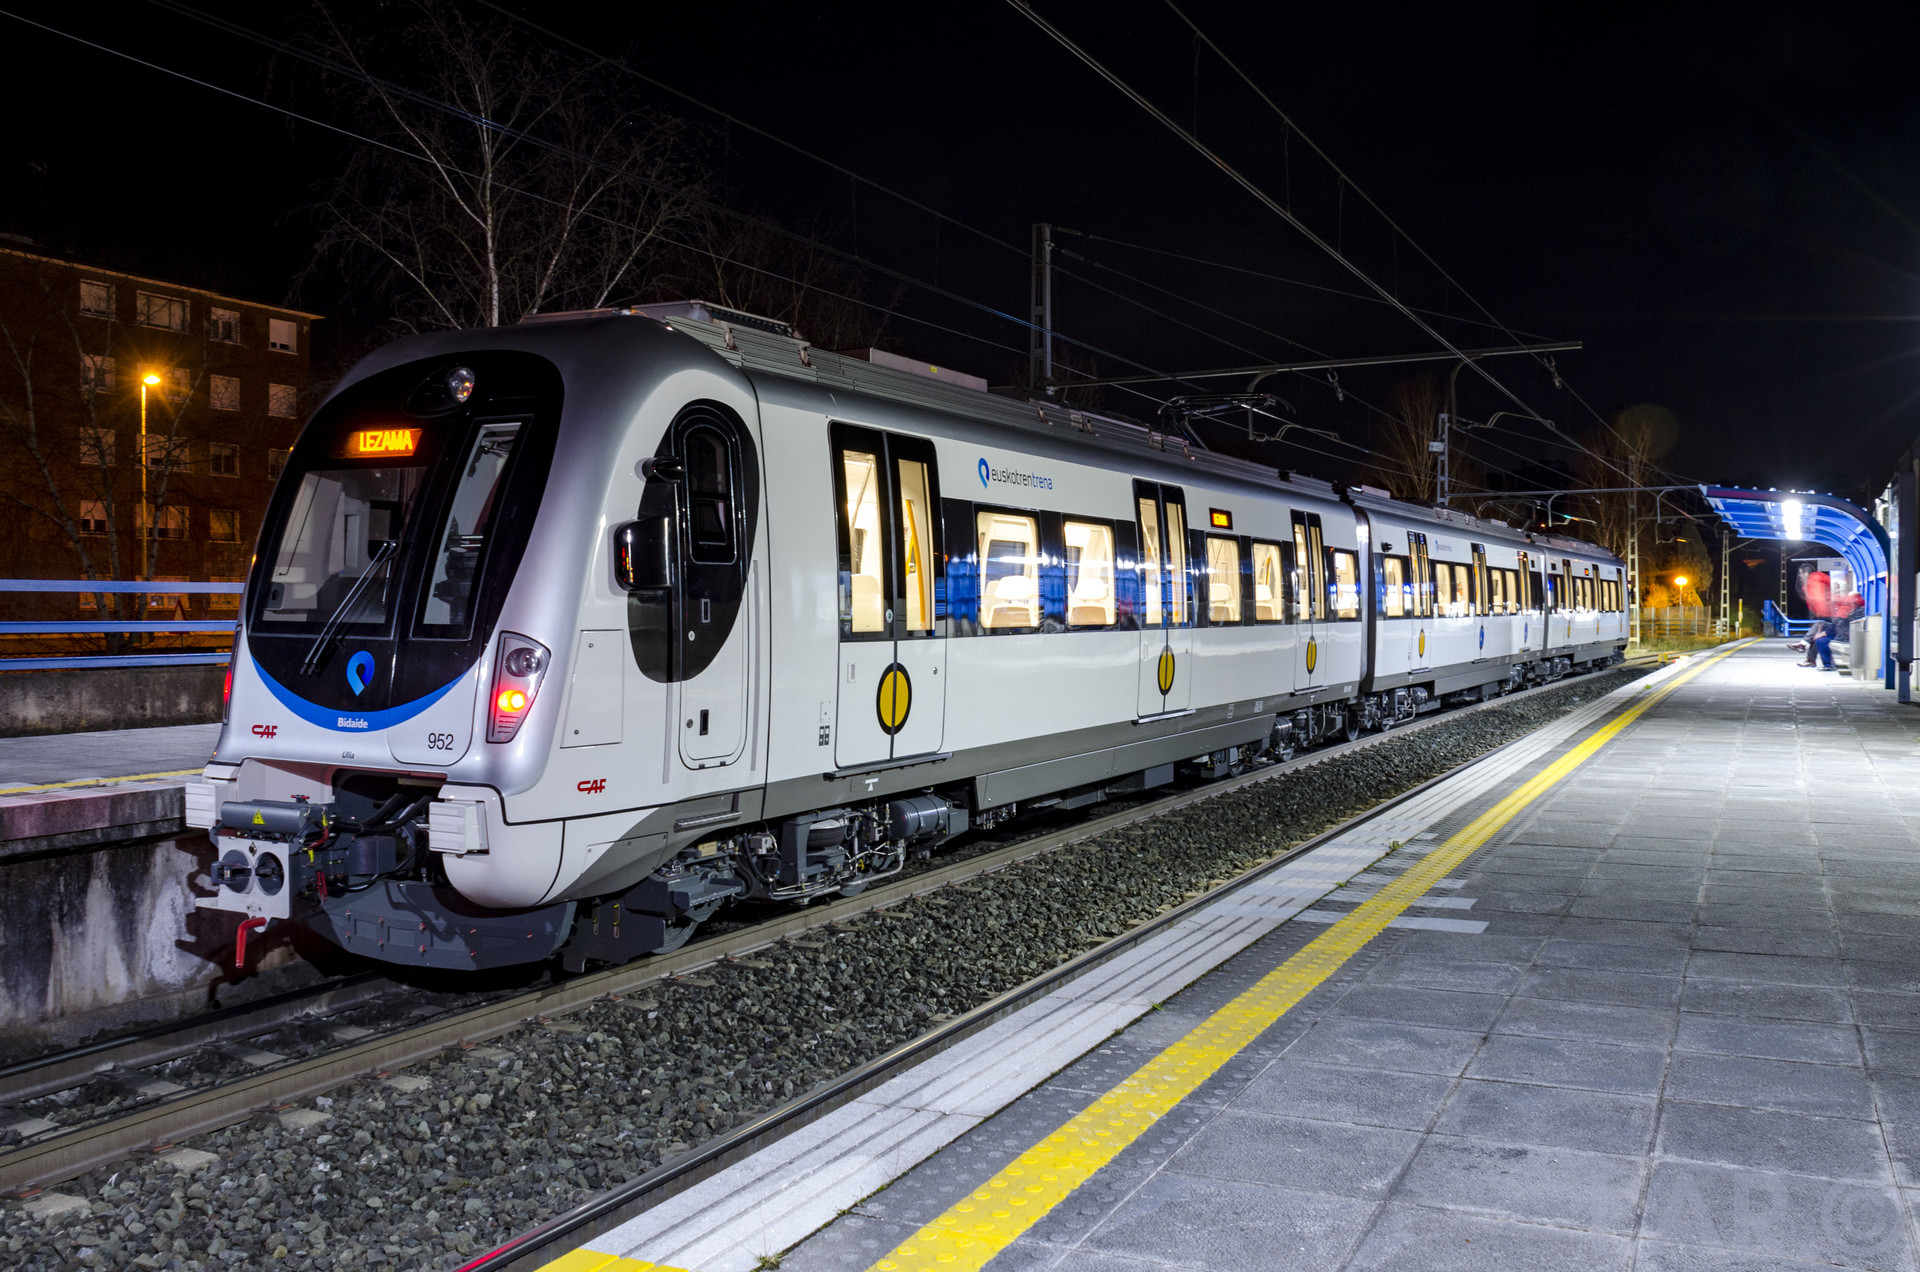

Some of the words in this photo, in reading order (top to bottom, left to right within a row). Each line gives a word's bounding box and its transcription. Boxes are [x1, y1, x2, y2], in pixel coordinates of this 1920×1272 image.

[360, 431, 413, 451] LEZAMA
[991, 467, 1053, 490] euskotrentrena
[251, 724, 278, 739] CAF
[337, 717, 369, 729] Bidaide
[428, 732, 454, 750] 952
[577, 778, 607, 795] CAF
